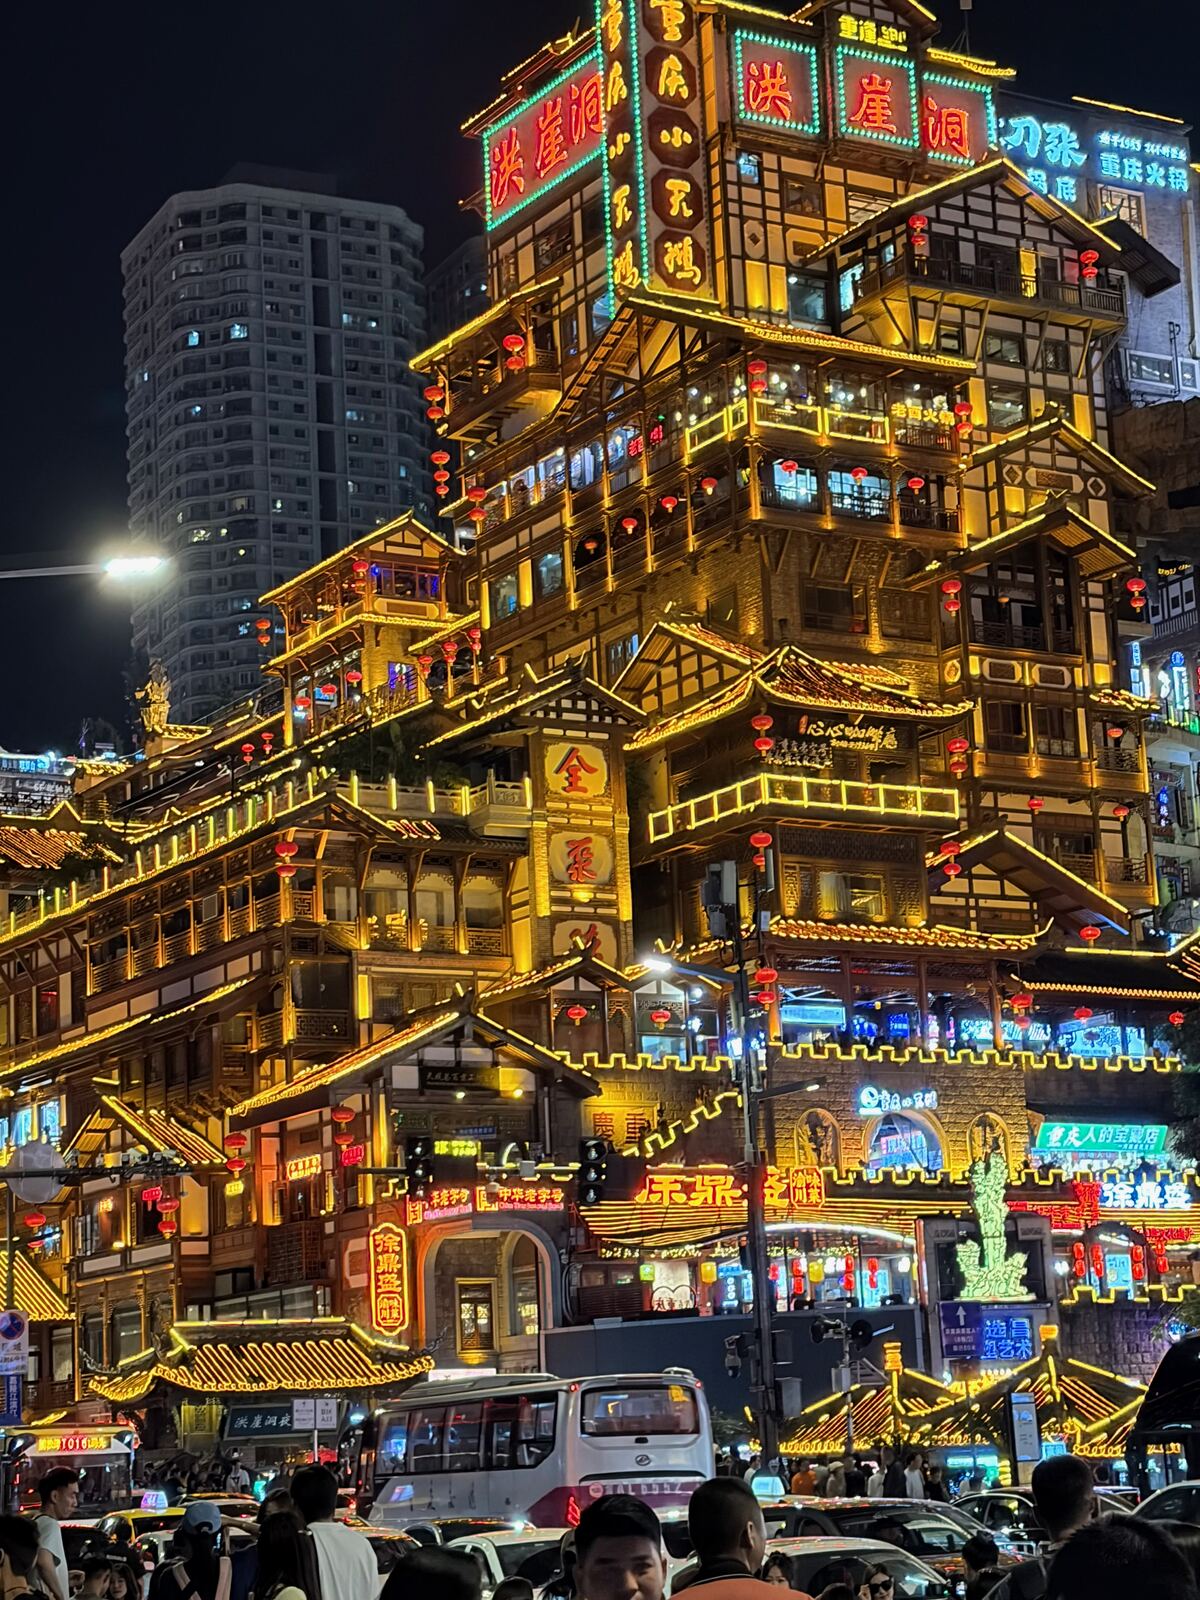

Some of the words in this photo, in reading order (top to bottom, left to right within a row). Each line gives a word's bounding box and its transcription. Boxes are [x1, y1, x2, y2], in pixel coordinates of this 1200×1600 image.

[490, 71, 605, 208] 洪崖洞
[747, 62, 971, 158] 洪崖洞
[650, 0, 701, 285] 重庆小天鹅
[1100, 151, 1189, 192] 重庆火锅
[499, 1187, 564, 1203] 中华老字号
[1103, 1182, 1191, 1209] 徐鼎盛
[375, 1234, 402, 1293] 徐鼎盛
